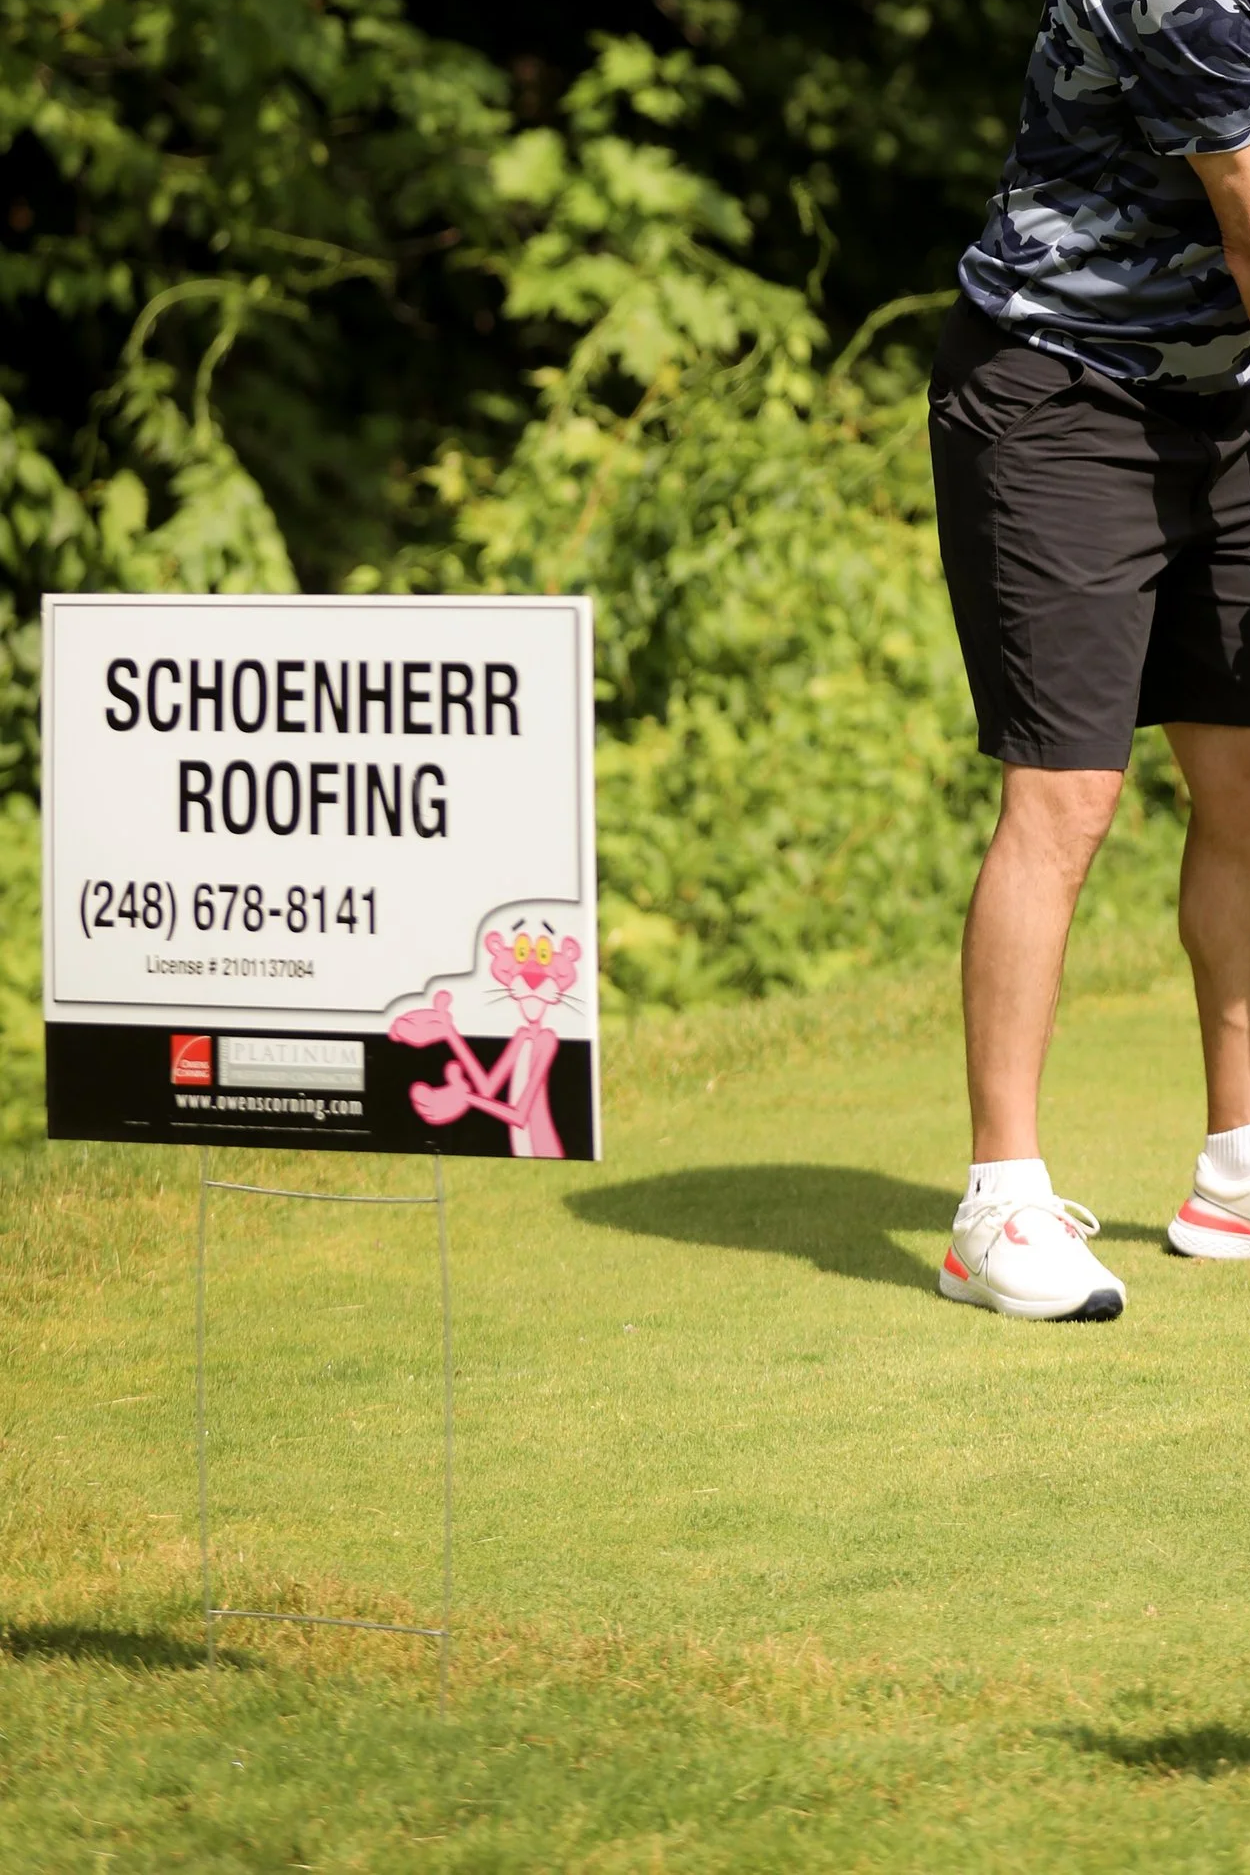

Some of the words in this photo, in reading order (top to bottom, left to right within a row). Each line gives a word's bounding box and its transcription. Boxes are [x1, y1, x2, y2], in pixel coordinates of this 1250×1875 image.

[105, 657, 522, 736] SCHOENHERR
[178, 759, 448, 839] ROOFING
[80, 878, 177, 942] (248)
[193, 882, 377, 935] 678-8141
[146, 955, 204, 975] License
[222, 957, 315, 978] 2101137084
[233, 1042, 358, 1065] PLATINUM
[174, 1092, 364, 1121] www.owenscorning.com
